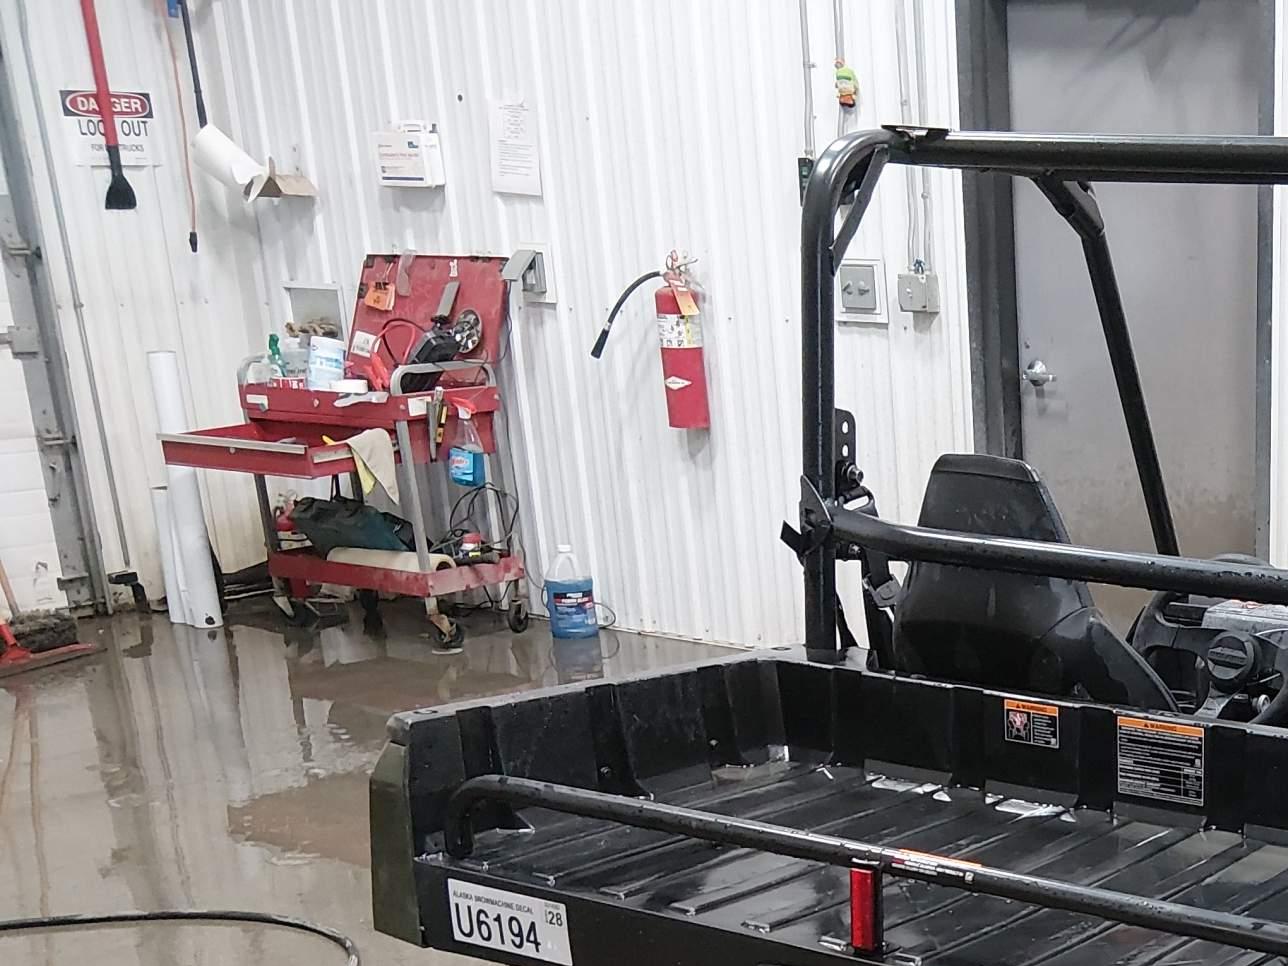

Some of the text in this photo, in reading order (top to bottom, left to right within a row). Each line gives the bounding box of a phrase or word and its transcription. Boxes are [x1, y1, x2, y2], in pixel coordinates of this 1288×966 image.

[76, 96, 143, 113] DAGER
[78, 118, 148, 137] LOC OUT
[453, 890, 474, 901] ALASKA
[515, 903, 534, 915] DECAL
[454, 902, 542, 953] U6194
[548, 910, 564, 927] 28
